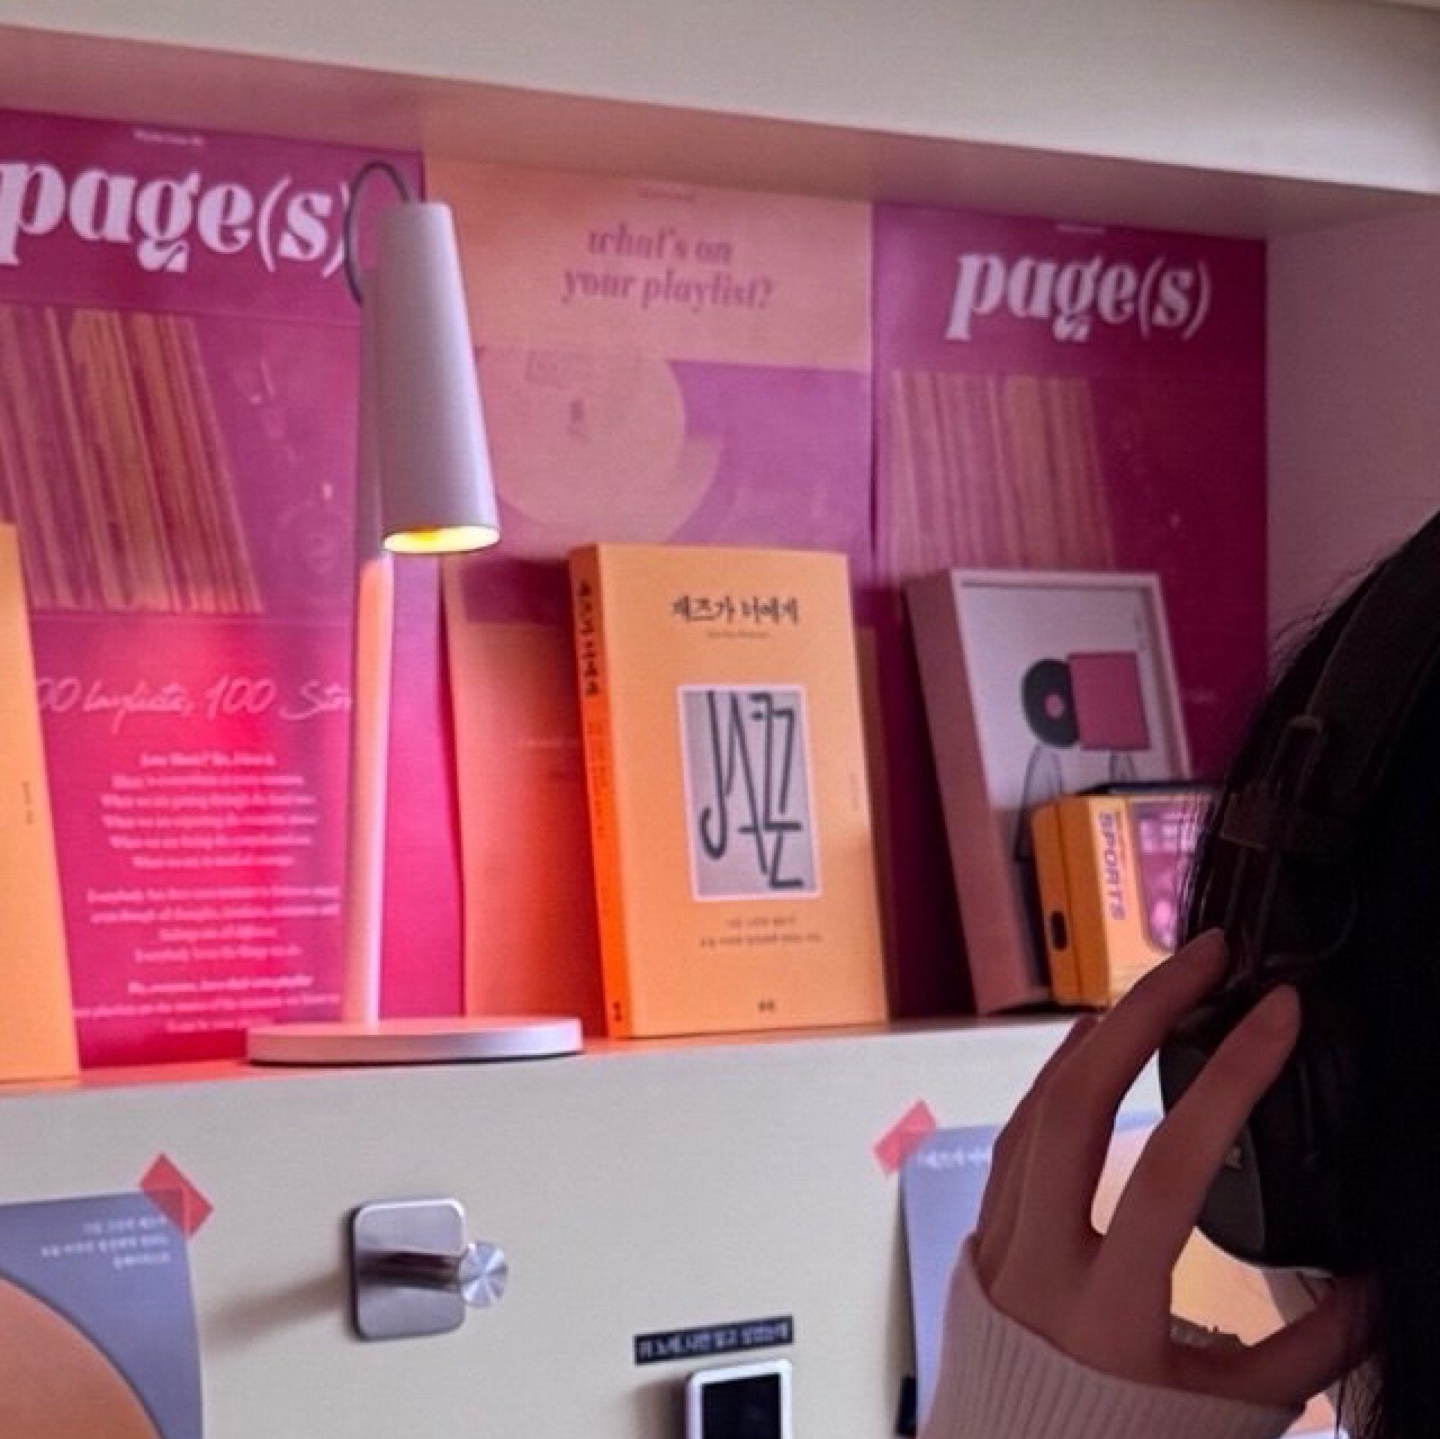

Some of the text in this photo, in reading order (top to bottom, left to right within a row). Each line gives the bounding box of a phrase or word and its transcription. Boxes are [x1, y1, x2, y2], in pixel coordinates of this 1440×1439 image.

[587, 222, 733, 263] what's on
[561, 268, 775, 314] your playlist?
[945, 252, 1212, 343] page(s)
[671, 595, 800, 626] 재즈가 너에게
[207, 674, 278, 720] 100
[1098, 811, 1126, 921] SPORTS
